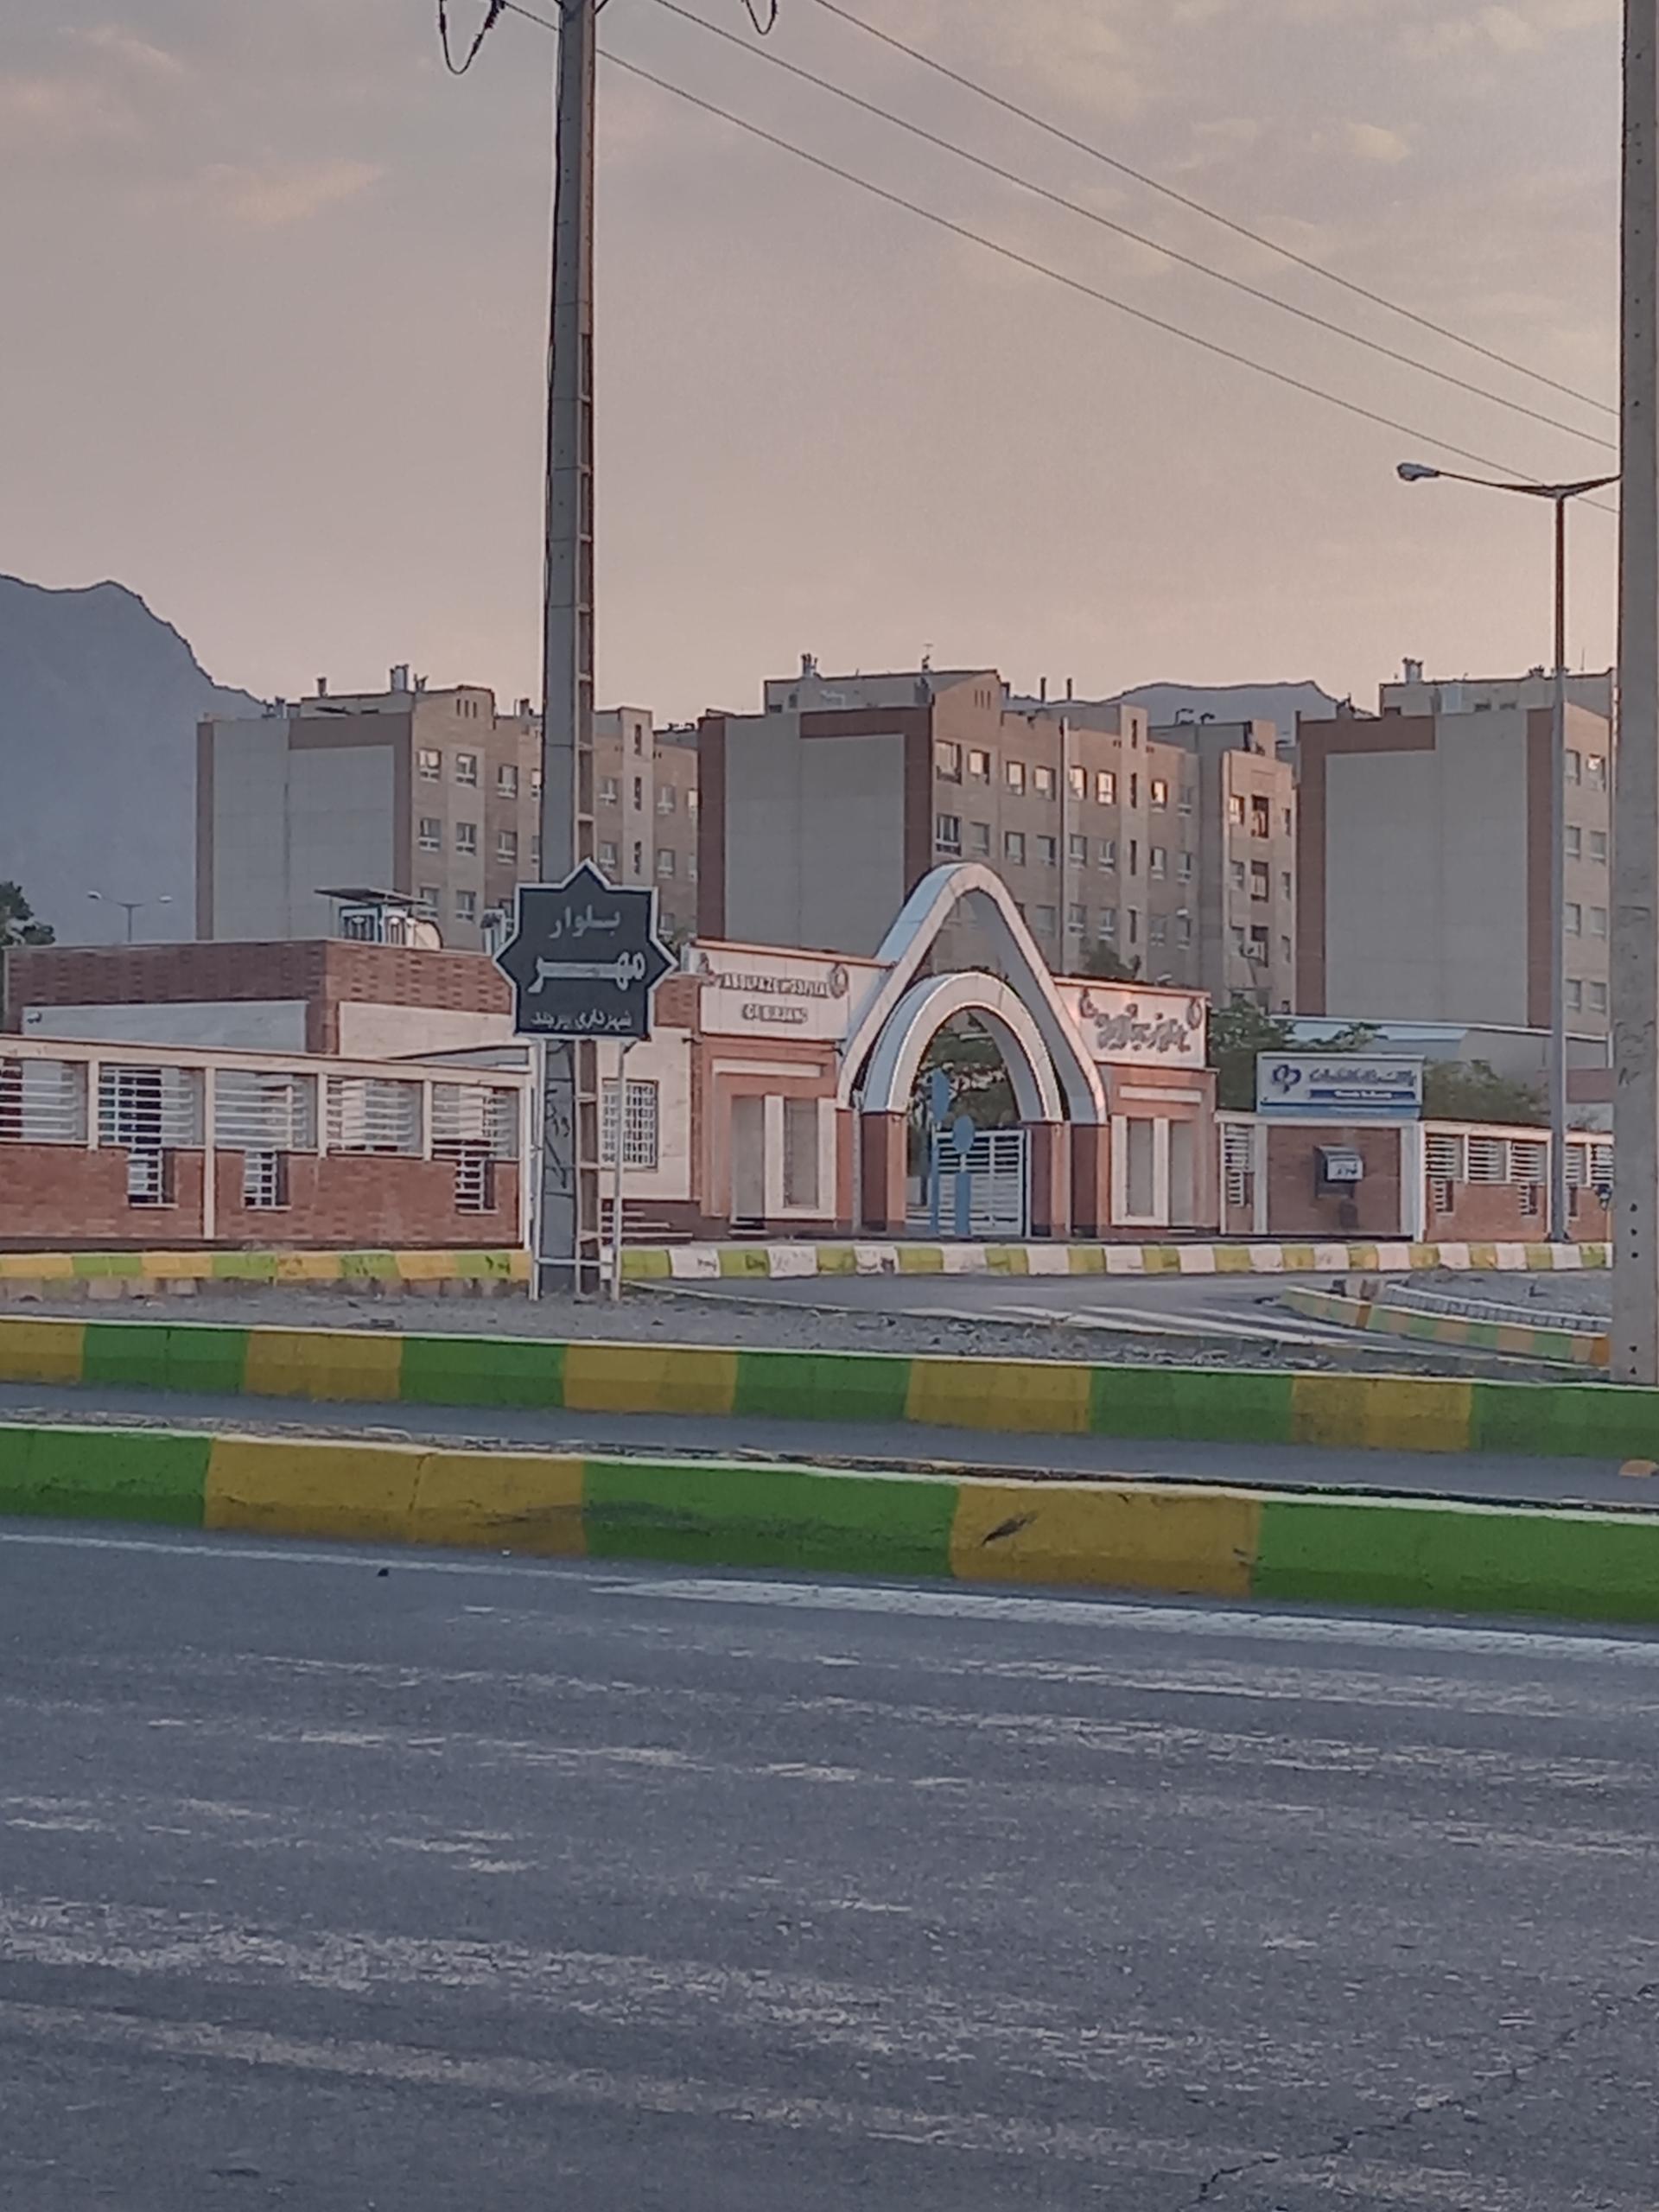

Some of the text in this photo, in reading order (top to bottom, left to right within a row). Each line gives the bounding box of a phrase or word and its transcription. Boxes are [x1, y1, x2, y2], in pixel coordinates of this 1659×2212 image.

[548, 904, 621, 938] بلوار
[526, 951, 646, 993] مهر
[575, 1008, 632, 1031] شهرداری
